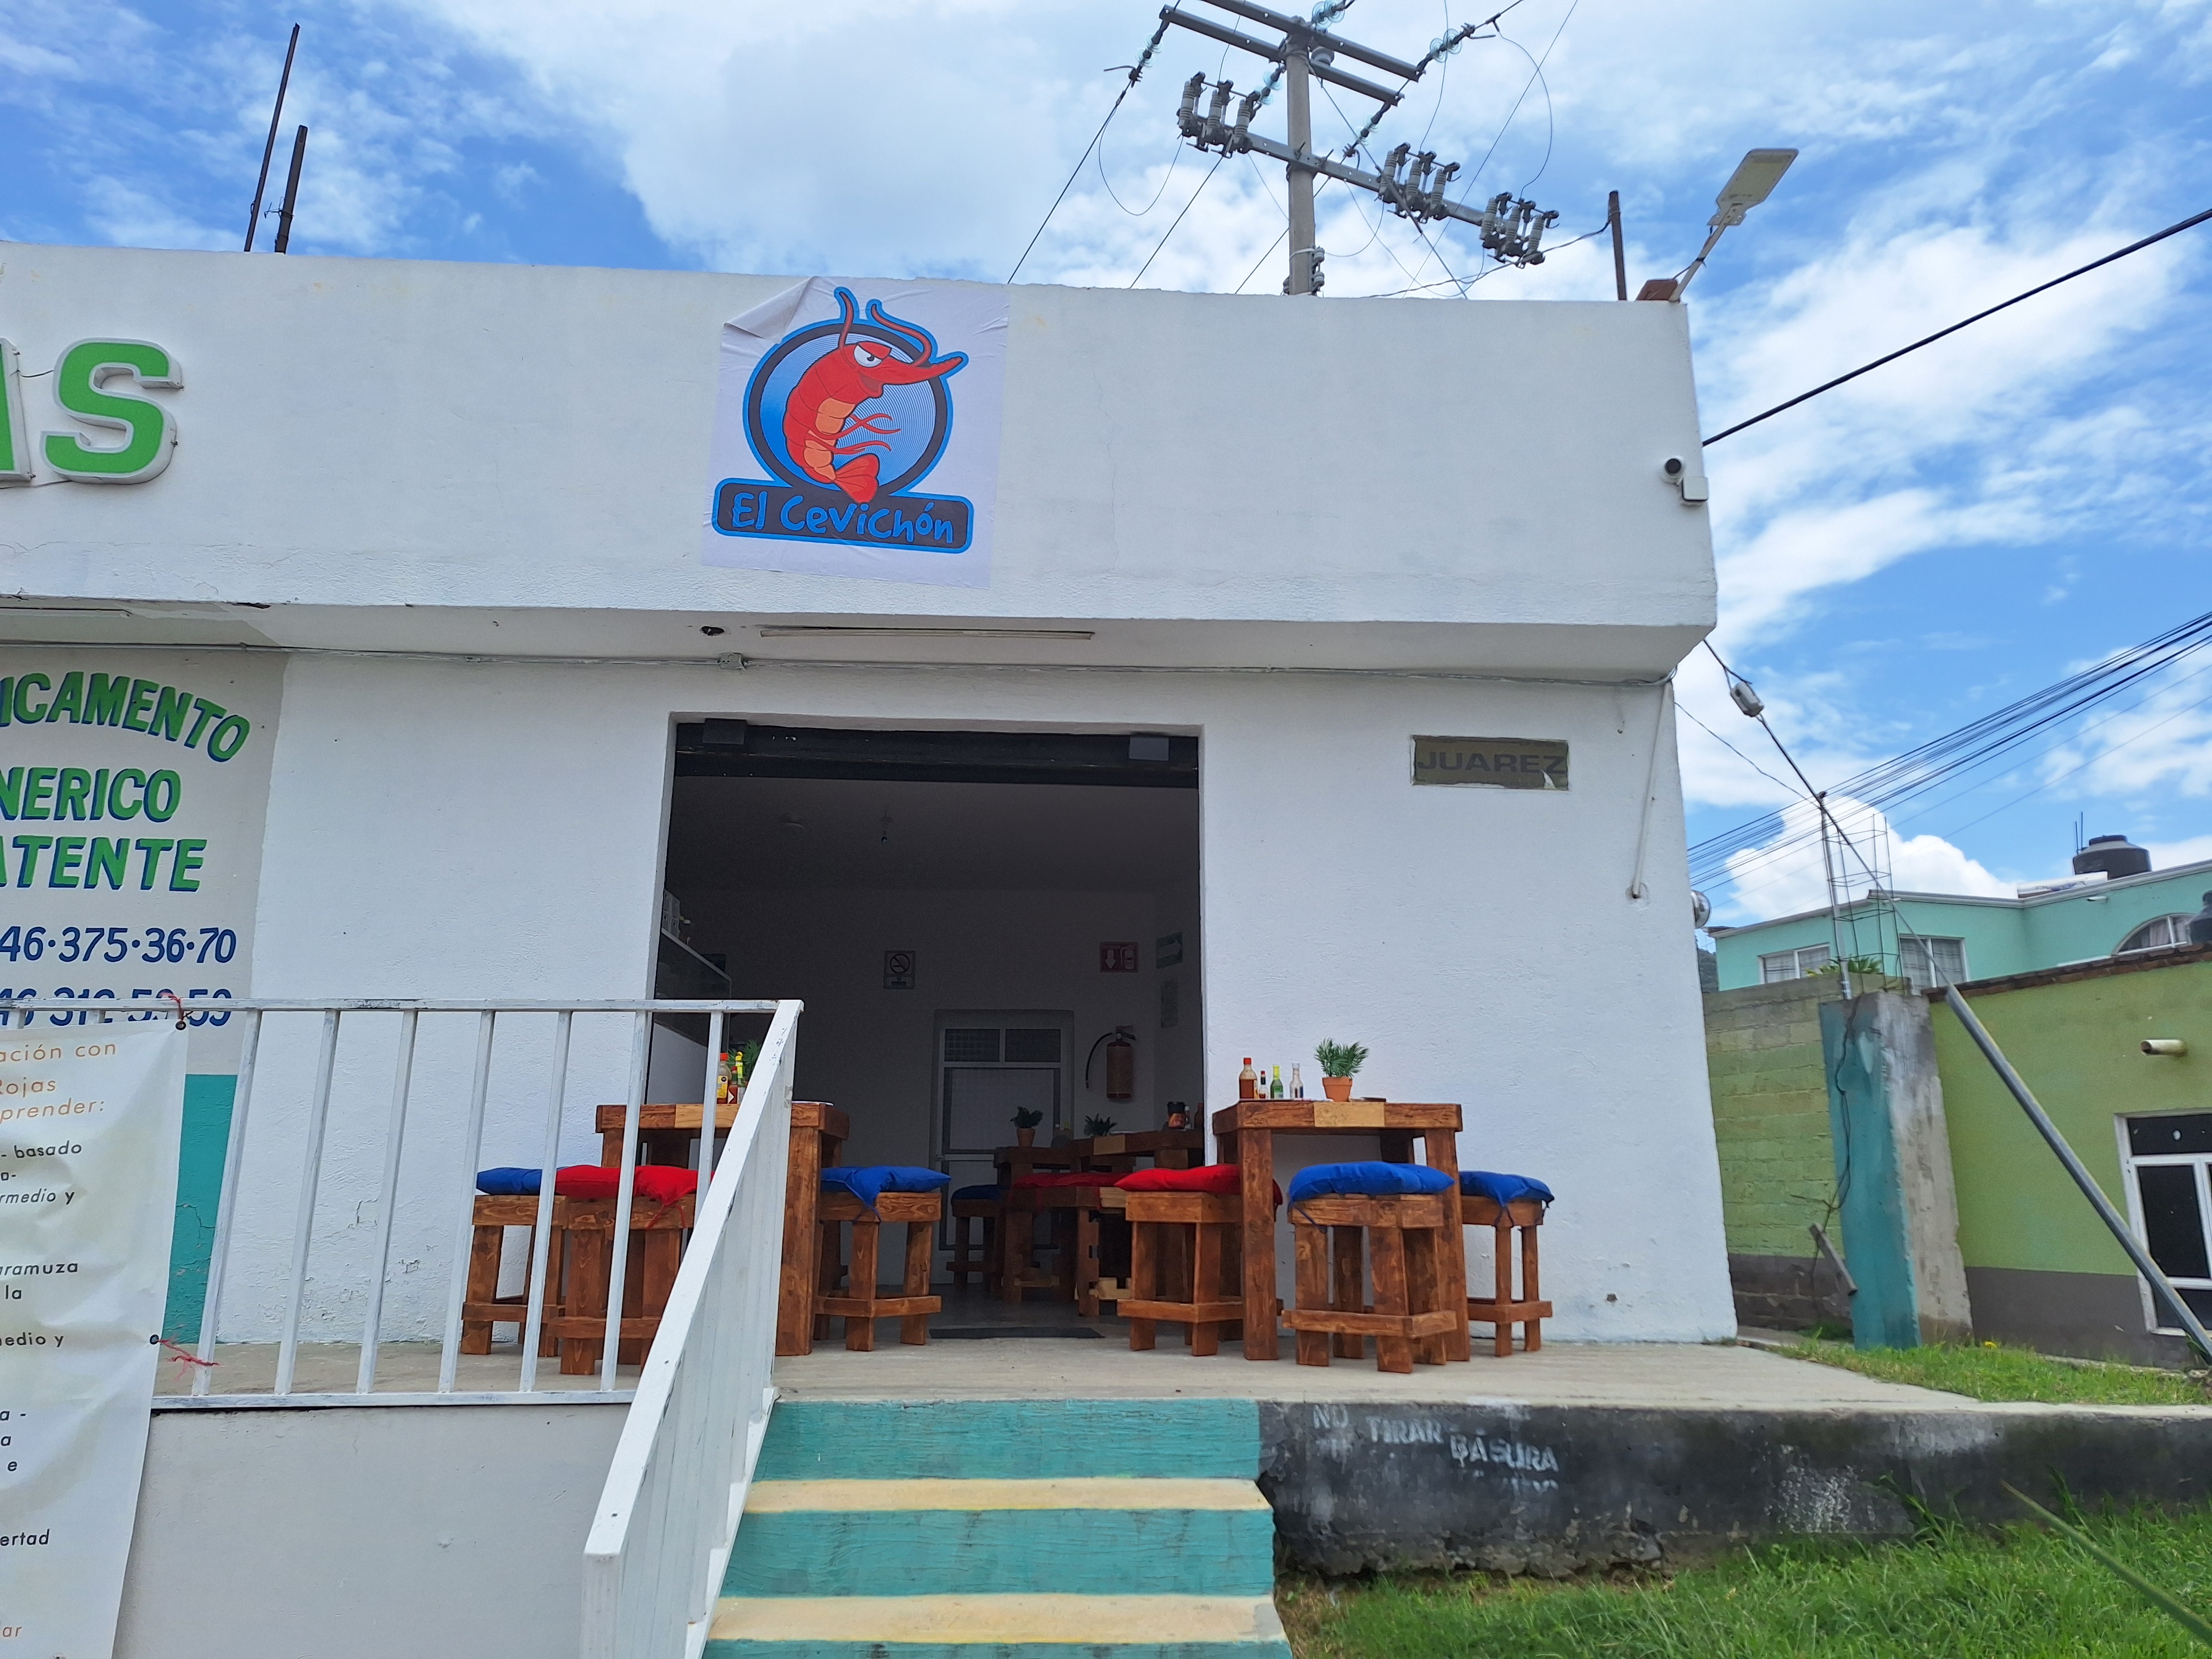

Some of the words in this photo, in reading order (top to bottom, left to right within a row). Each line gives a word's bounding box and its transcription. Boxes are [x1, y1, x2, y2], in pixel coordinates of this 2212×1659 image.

[731, 491, 767, 529] El
[0, 671, 250, 762] ICAMENTO
[1417, 751, 1566, 774] JUAREZ
[0, 767, 182, 822] NERICO
[75, 1044, 115, 1057] con
[0, 1077, 56, 1098] ojas
[0, 1097, 105, 1124] prender:
[14, 1140, 82, 1159] basado
[65, 1191, 75, 1205] y
[0, 1263, 78, 1276] ramuza
[5, 1284, 22, 1300] la
[0, 1332, 46, 1346] edio
[54, 1335, 64, 1348] y
[1365, 1416, 1444, 1444] TIRAR
[1450, 1433, 1560, 1472] BASURA
[7, 1461, 17, 1472] e
[0, 1528, 50, 1546] ertad
